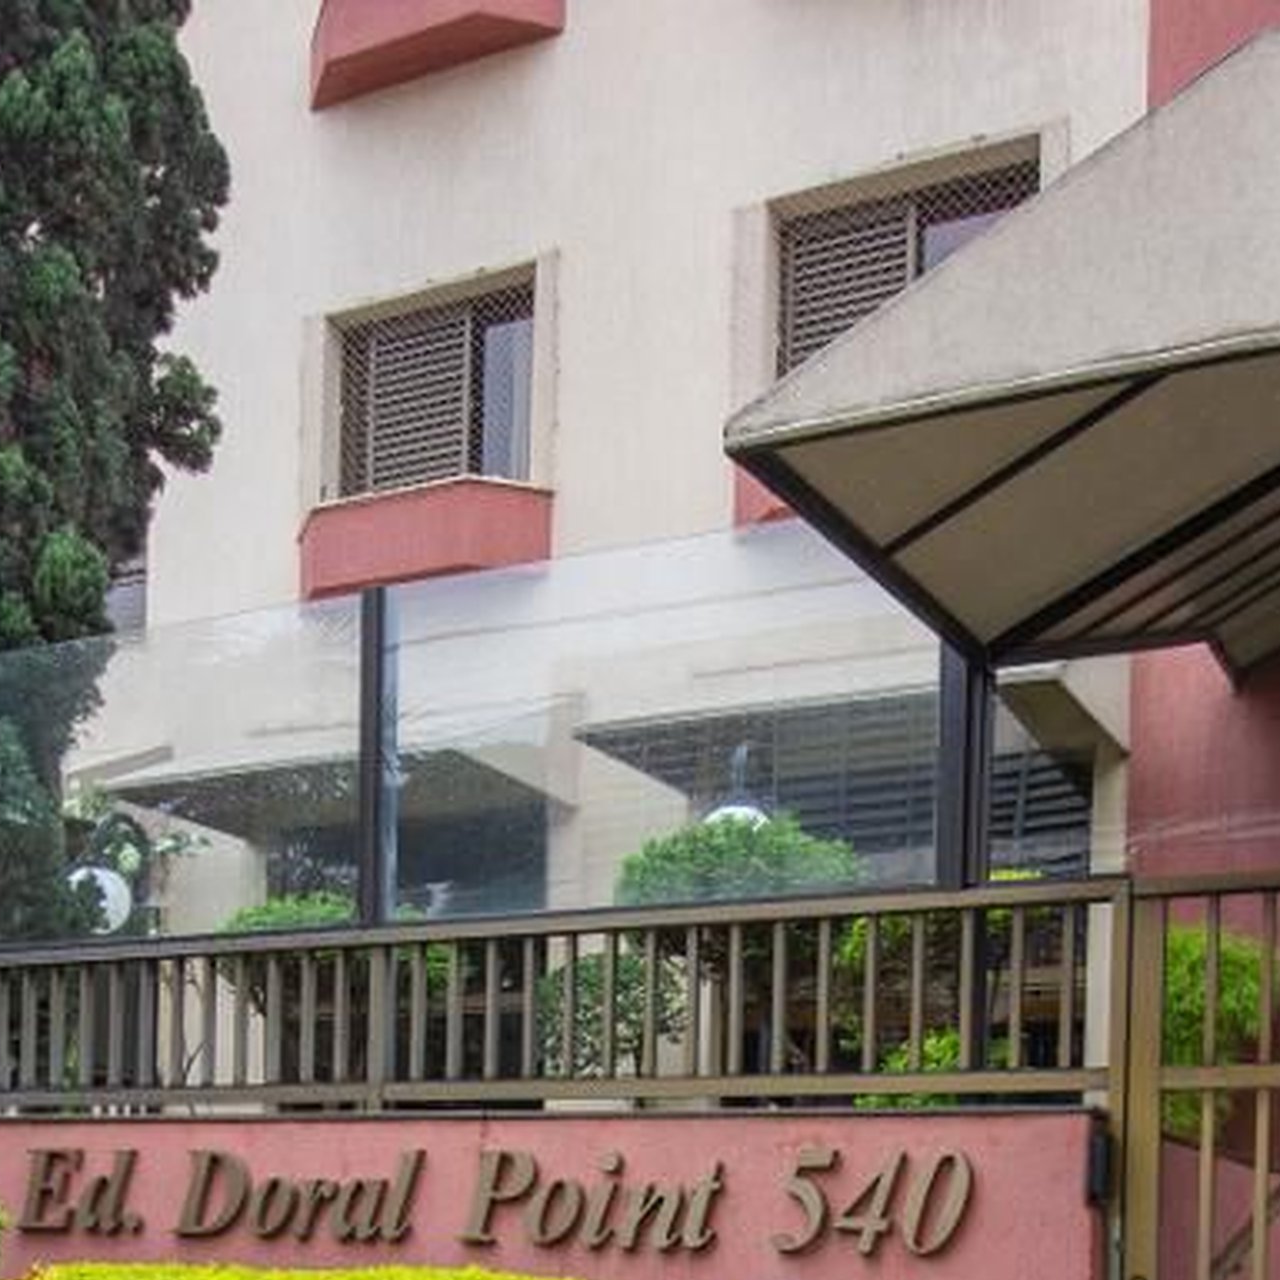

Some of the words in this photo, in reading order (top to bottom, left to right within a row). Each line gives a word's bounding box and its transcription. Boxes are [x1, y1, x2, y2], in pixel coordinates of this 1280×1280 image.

[17, 1148, 145, 1237] Ed.
[173, 1148, 426, 1246] Doral
[460, 1149, 724, 1254] Point
[774, 1147, 974, 1257] 540
